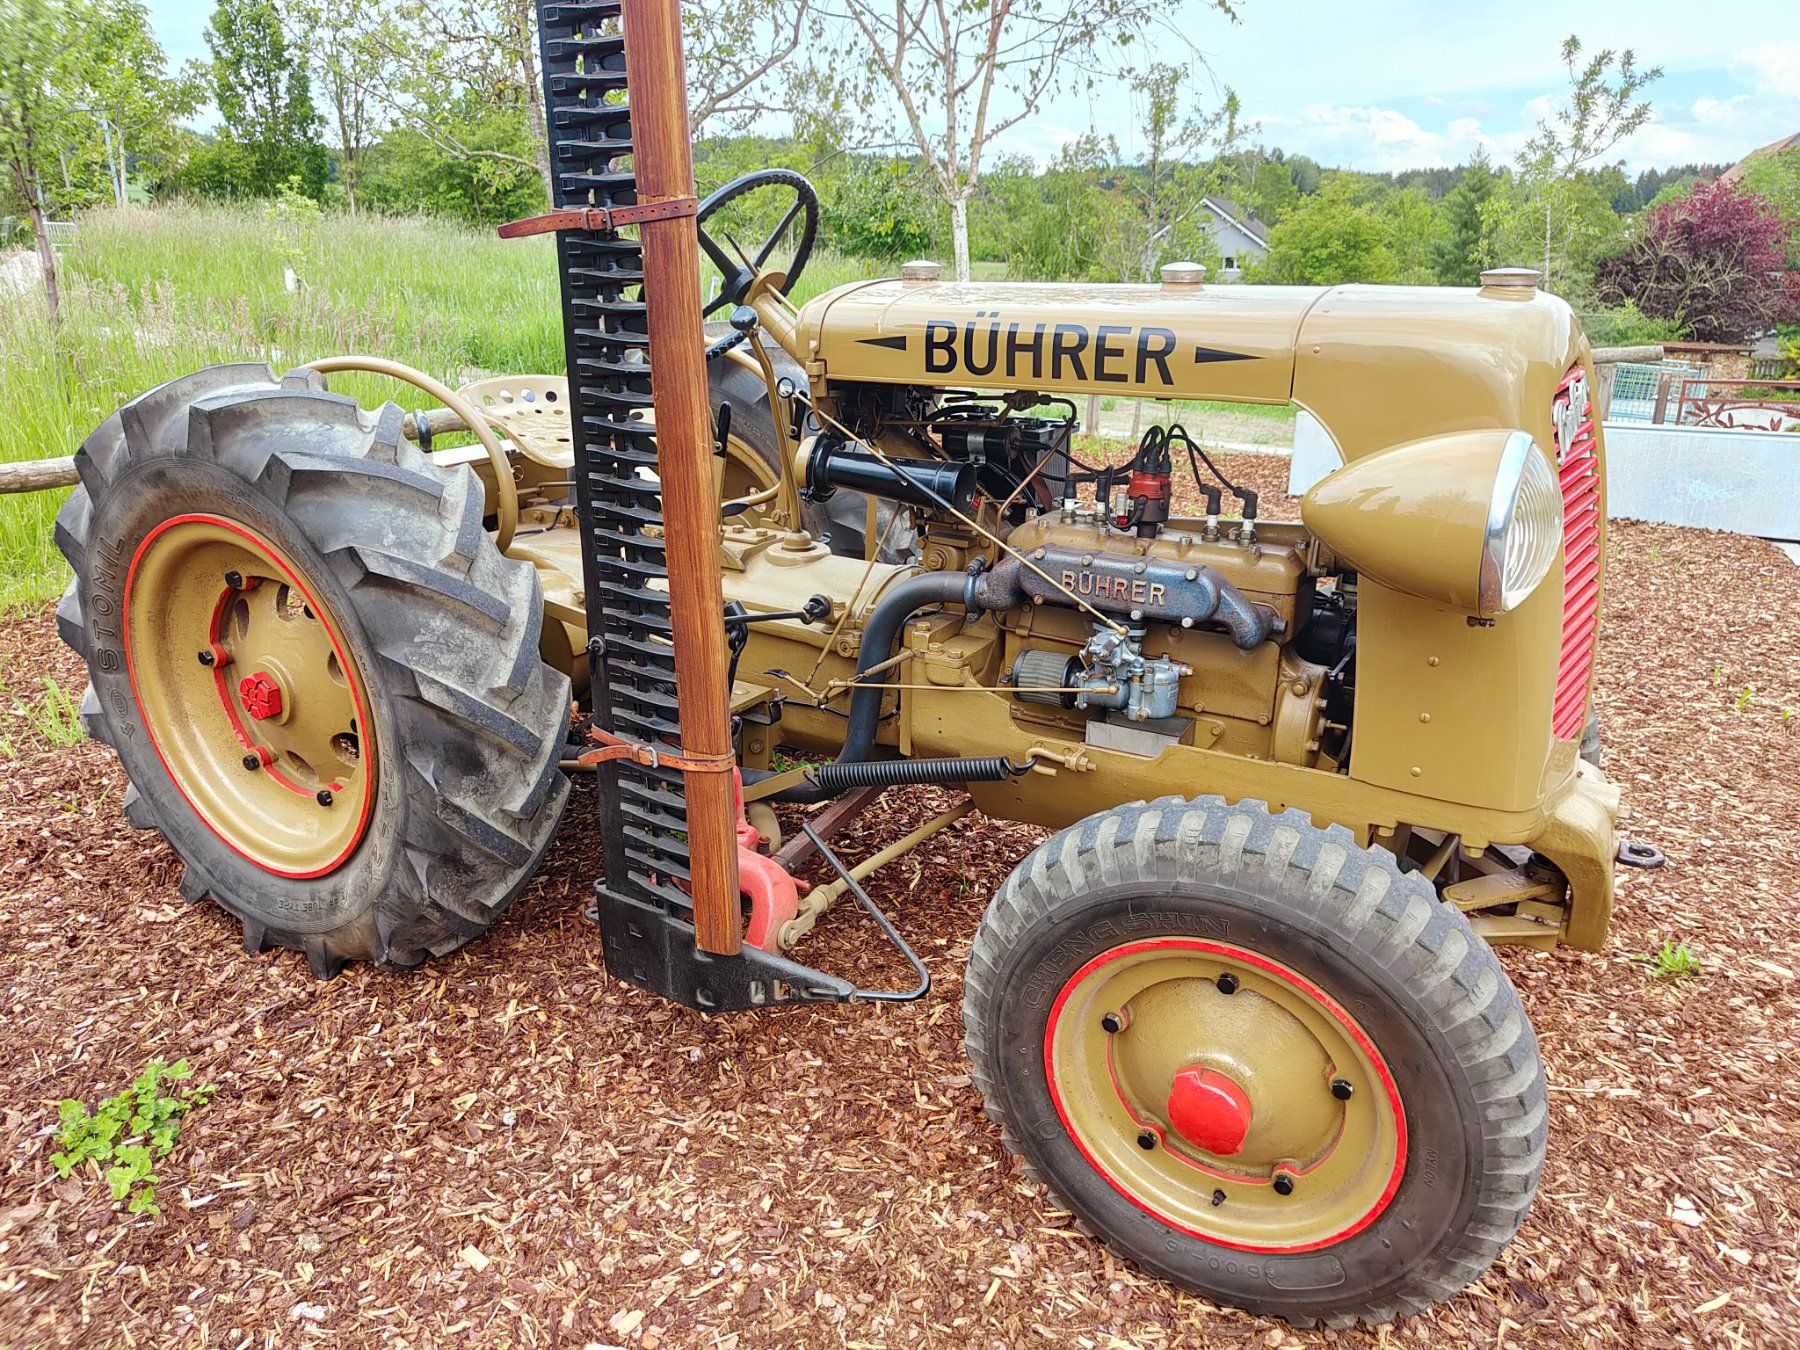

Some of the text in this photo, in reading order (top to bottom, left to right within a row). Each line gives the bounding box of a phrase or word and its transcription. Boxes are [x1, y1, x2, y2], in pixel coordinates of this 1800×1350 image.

[925, 312, 1176, 386] BÜHRER
[93, 536, 125, 673] STOMIL
[1062, 570, 1165, 606] BÜHRER
[302, 899, 322, 912] TUBE
[1021, 912, 1230, 1010] CHENG SHIN
[1423, 1147, 1438, 1189] NYLON
